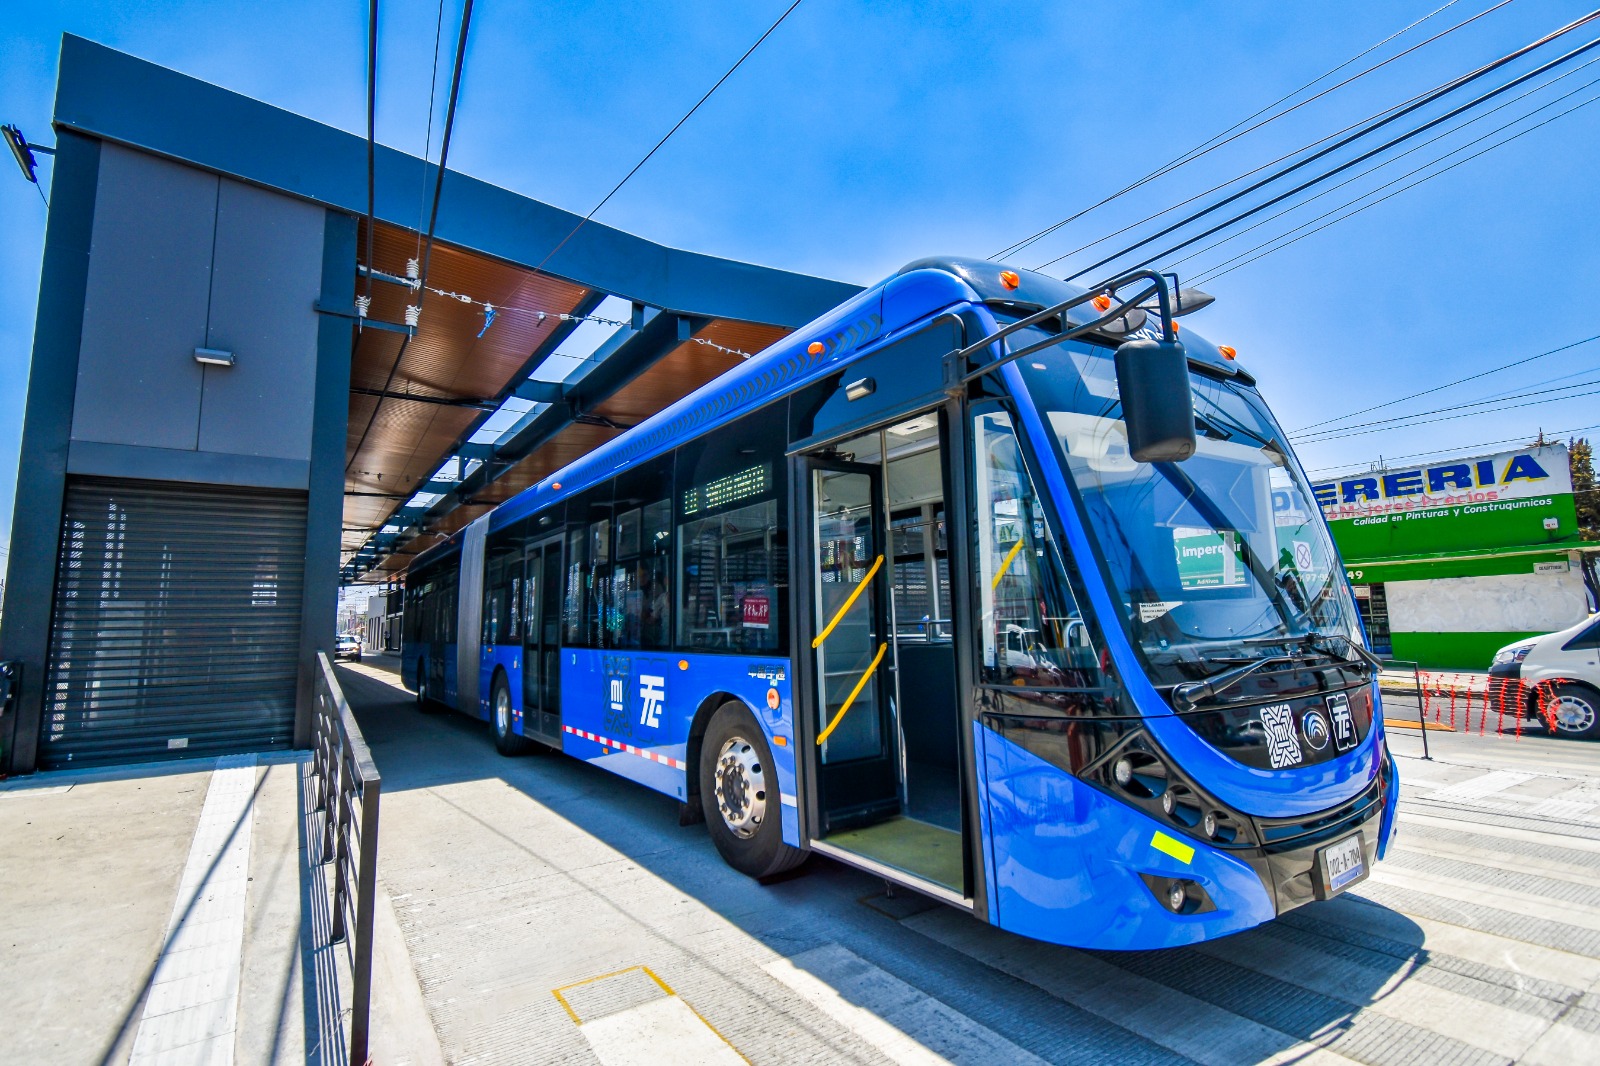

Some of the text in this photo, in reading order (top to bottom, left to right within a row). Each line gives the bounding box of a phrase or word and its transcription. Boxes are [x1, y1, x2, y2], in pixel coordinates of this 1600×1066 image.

[1353, 515, 1388, 526] Calidad
[1406, 509, 1449, 520] Pinturas
[1453, 508, 1460, 516] y
[1346, 570, 1364, 580] 49
